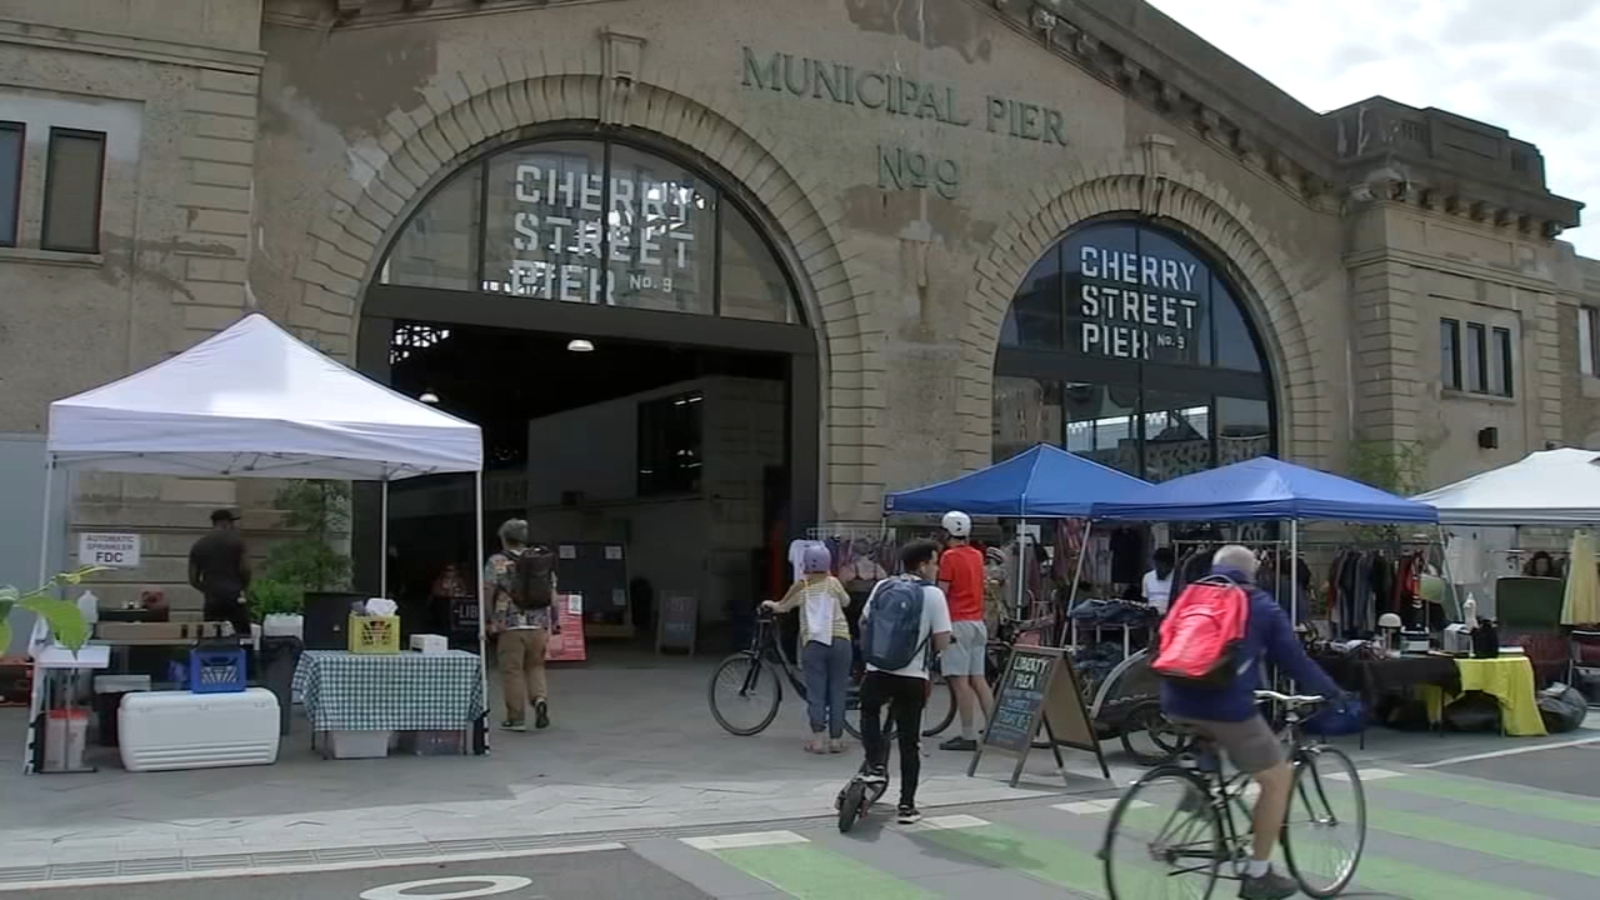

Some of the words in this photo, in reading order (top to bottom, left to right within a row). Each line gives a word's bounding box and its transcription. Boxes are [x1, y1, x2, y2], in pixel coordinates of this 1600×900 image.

[740, 46, 970, 127] MUNICIPAL
[985, 95, 1067, 147] PIER
[515, 164, 695, 222] CHERRY
[513, 211, 695, 270] STREET
[511, 258, 617, 307] PIER
[1081, 246, 1196, 292] CHERRY
[1081, 284, 1198, 330] STREET
[1082, 322, 1150, 361] PIER
[95, 551, 125, 563] FDC
[1013, 655, 1051, 675] LIBERTY
[1013, 673, 1037, 690] FLEA
